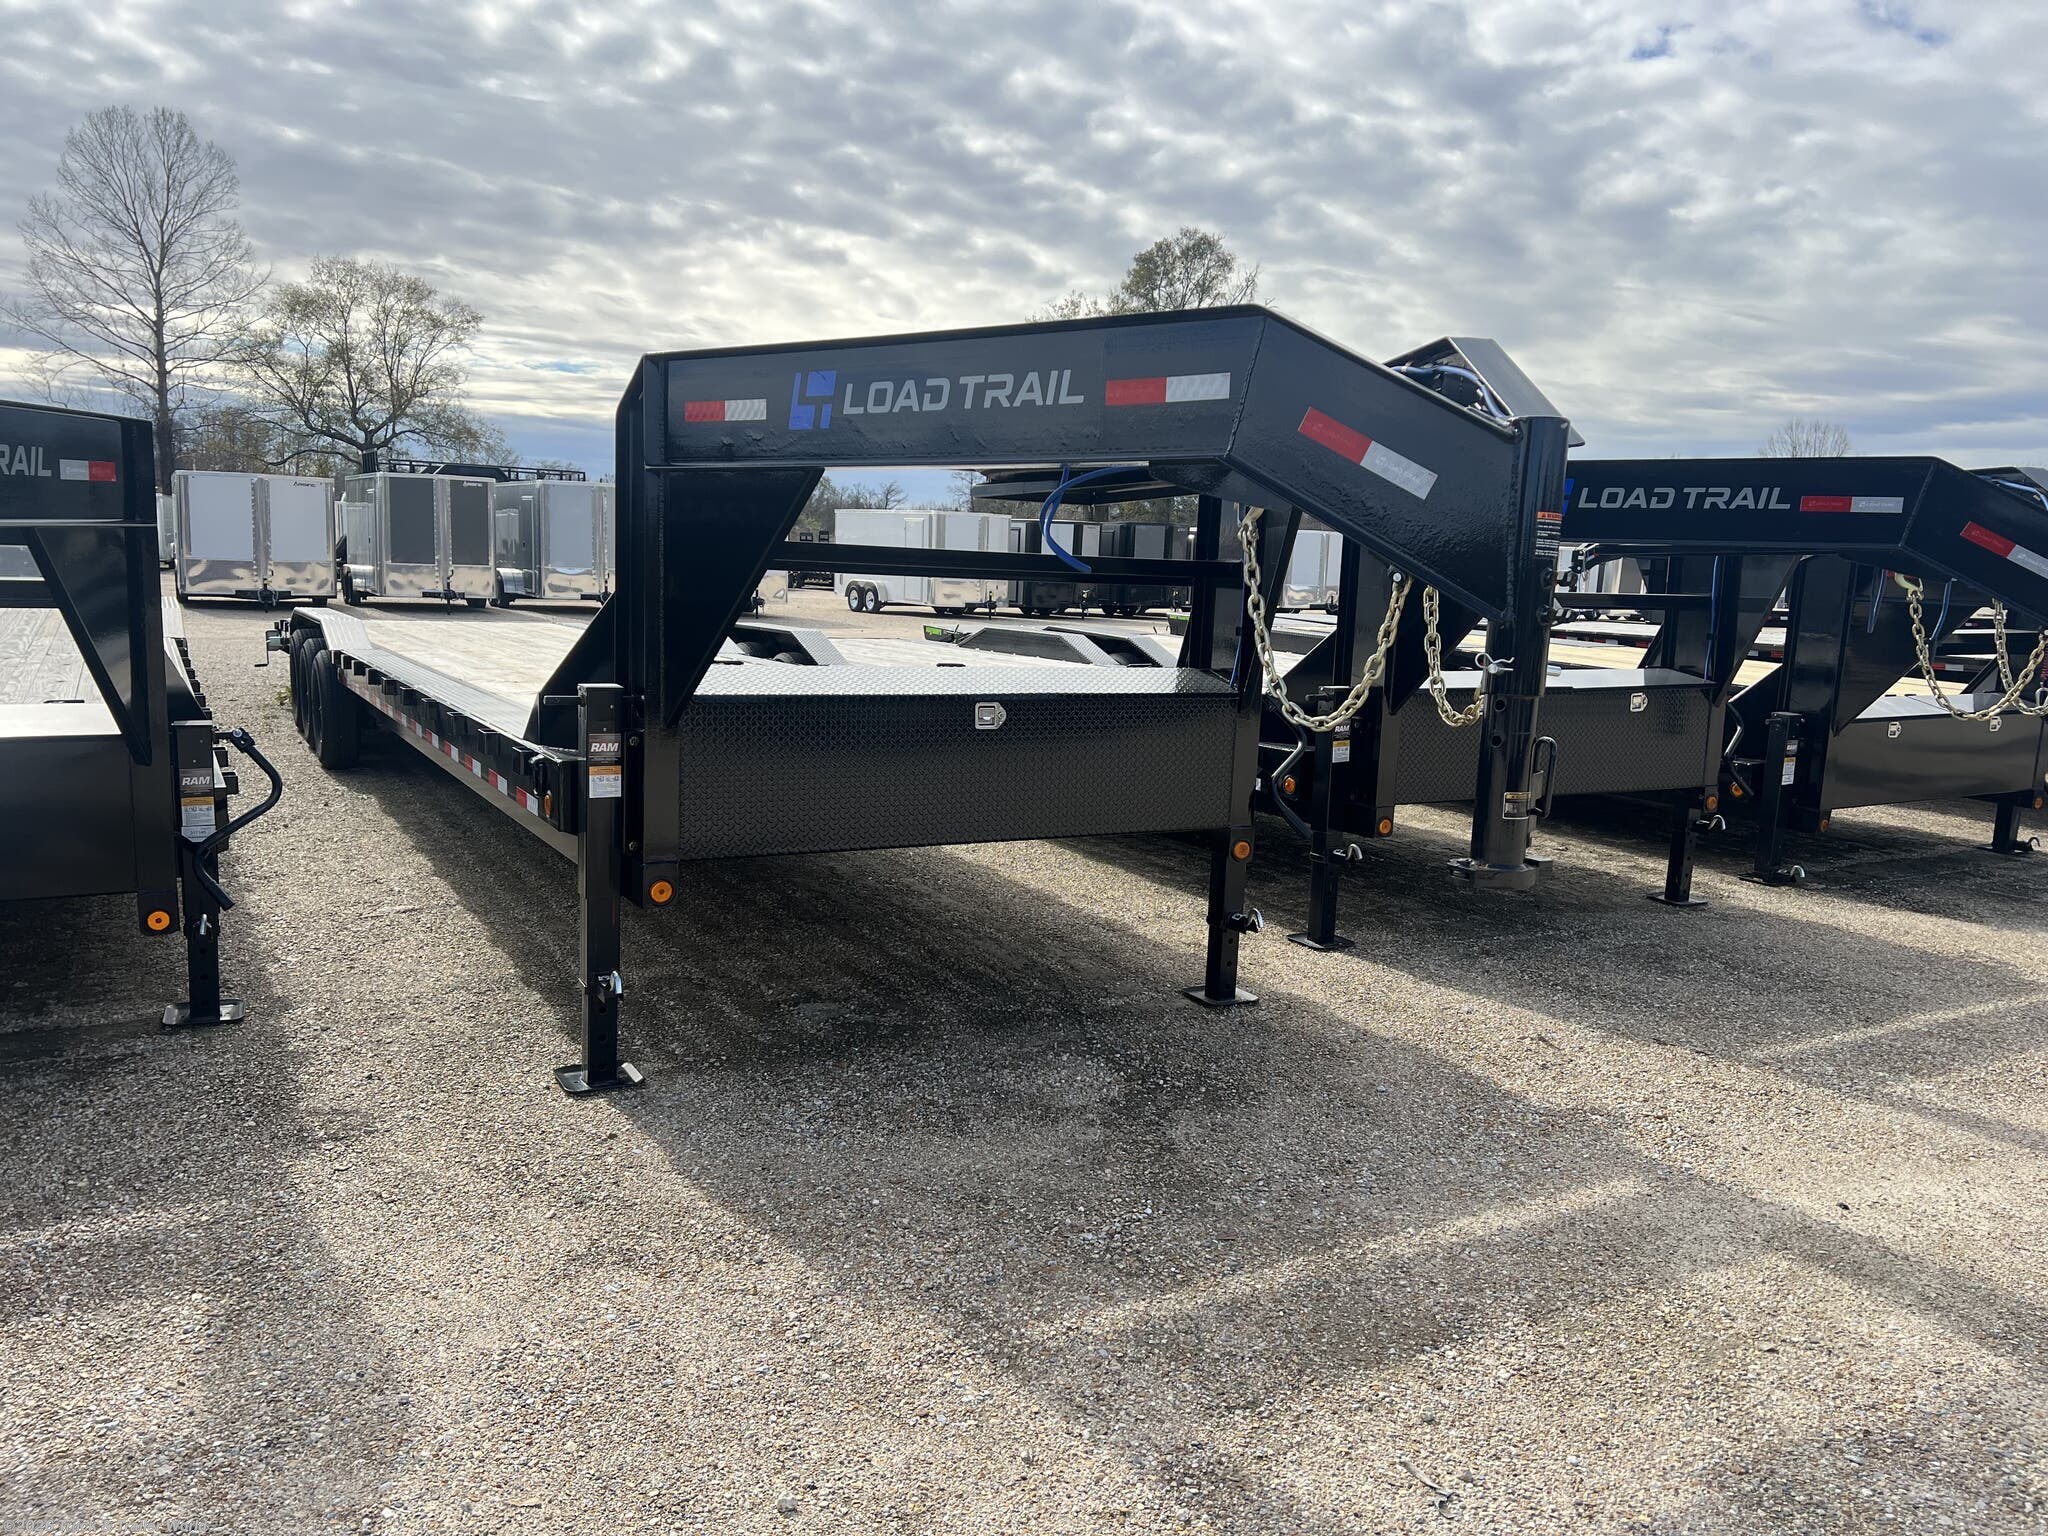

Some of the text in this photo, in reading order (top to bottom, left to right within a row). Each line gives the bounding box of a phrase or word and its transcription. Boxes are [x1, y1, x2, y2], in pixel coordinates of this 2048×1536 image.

[842, 369, 1085, 415] LOAD TRAIL
[1577, 486, 1791, 509] LOAD TRAIL
[590, 742, 619, 752] RAM
[182, 776, 210, 785] RAM
